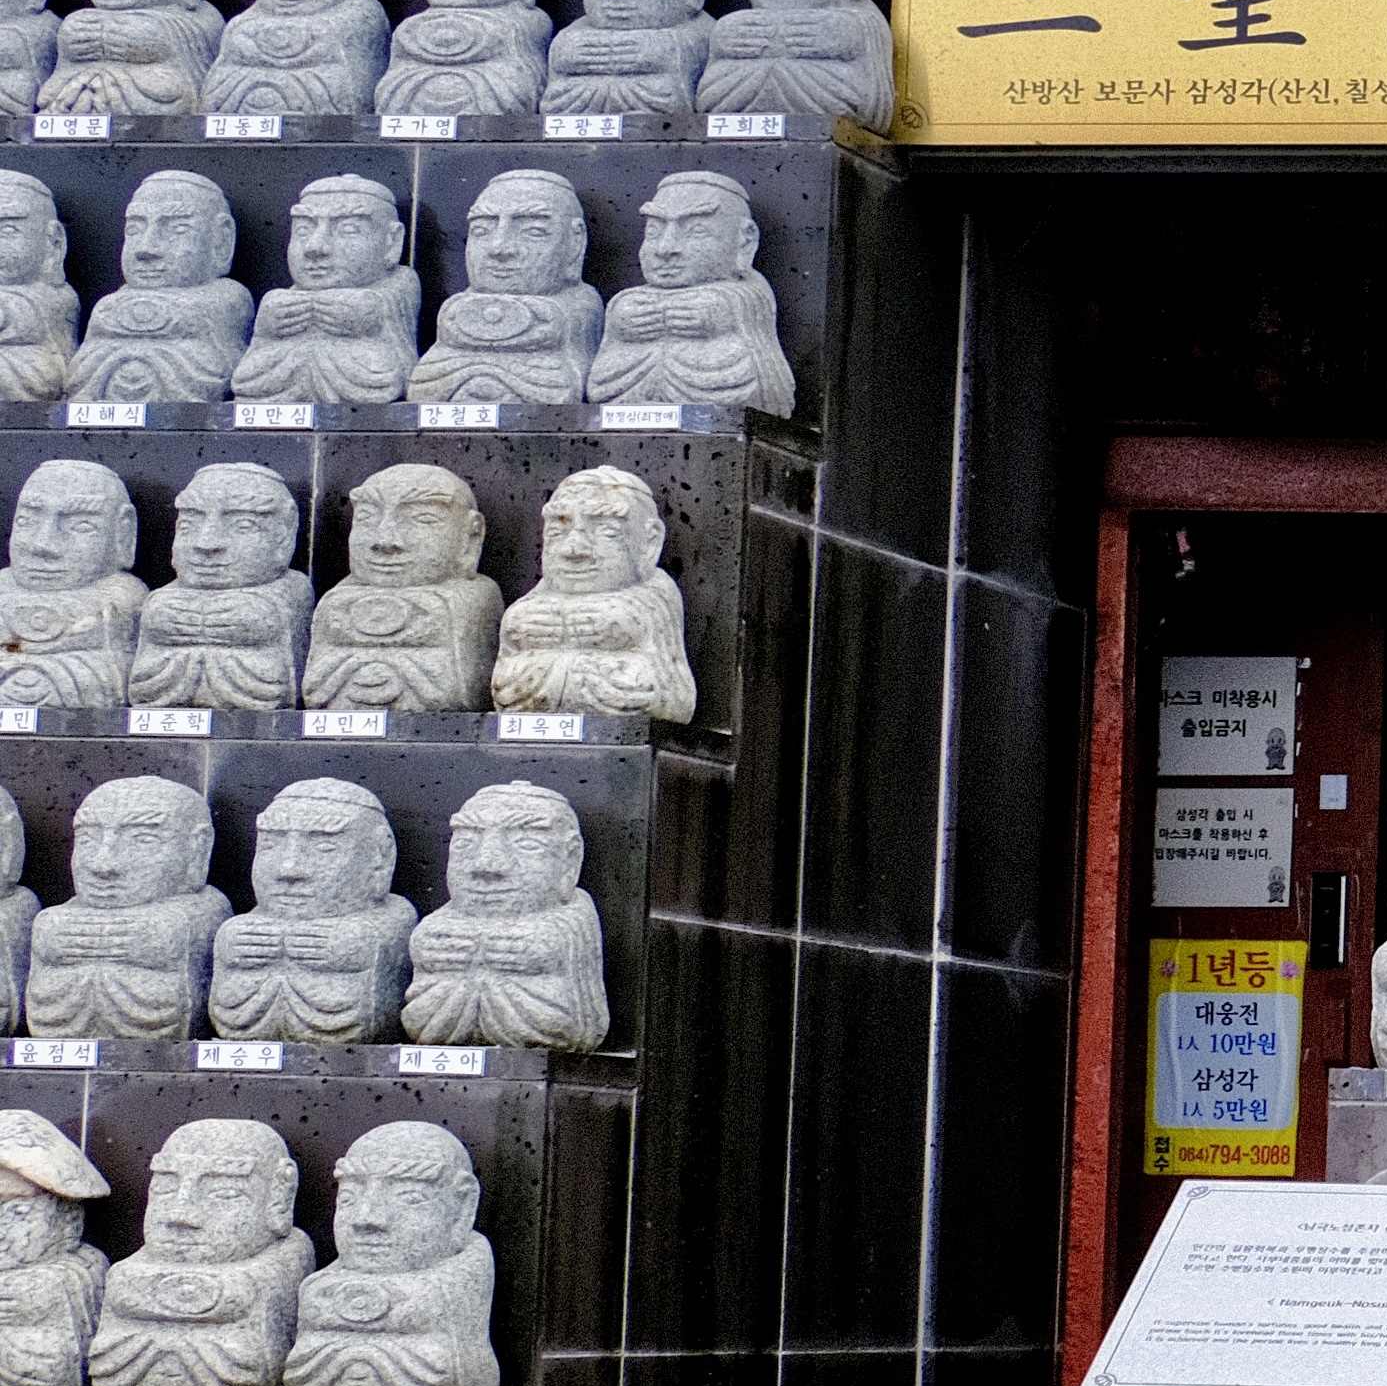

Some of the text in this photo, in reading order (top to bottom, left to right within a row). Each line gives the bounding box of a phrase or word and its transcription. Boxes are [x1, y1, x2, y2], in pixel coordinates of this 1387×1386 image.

[1003, 79, 1085, 106] 산방산
[1096, 79, 1176, 106] 보문사
[39, 117, 103, 135] 이영문
[212, 117, 276, 135] 김동희
[386, 117, 452, 135] 구가영
[712, 117, 780, 135] 구희찬
[1212, 690, 1277, 708] 미착용시
[135, 711, 205, 732] 심준학
[311, 713, 379, 735] 심민서
[506, 717, 575, 738] 최옥연
[1181, 718, 1246, 738] 출입금지
[1187, 949, 1275, 988] 1년등
[1195, 1000, 1259, 1026] 대웅전
[20, 1044, 91, 1063] 윤점석
[1211, 1031, 1276, 1056] 10만원
[202, 1045, 276, 1067] 제승우
[1191, 1067, 1259, 1093] 삼성각
[1213, 1098, 1268, 1122] 5만원
